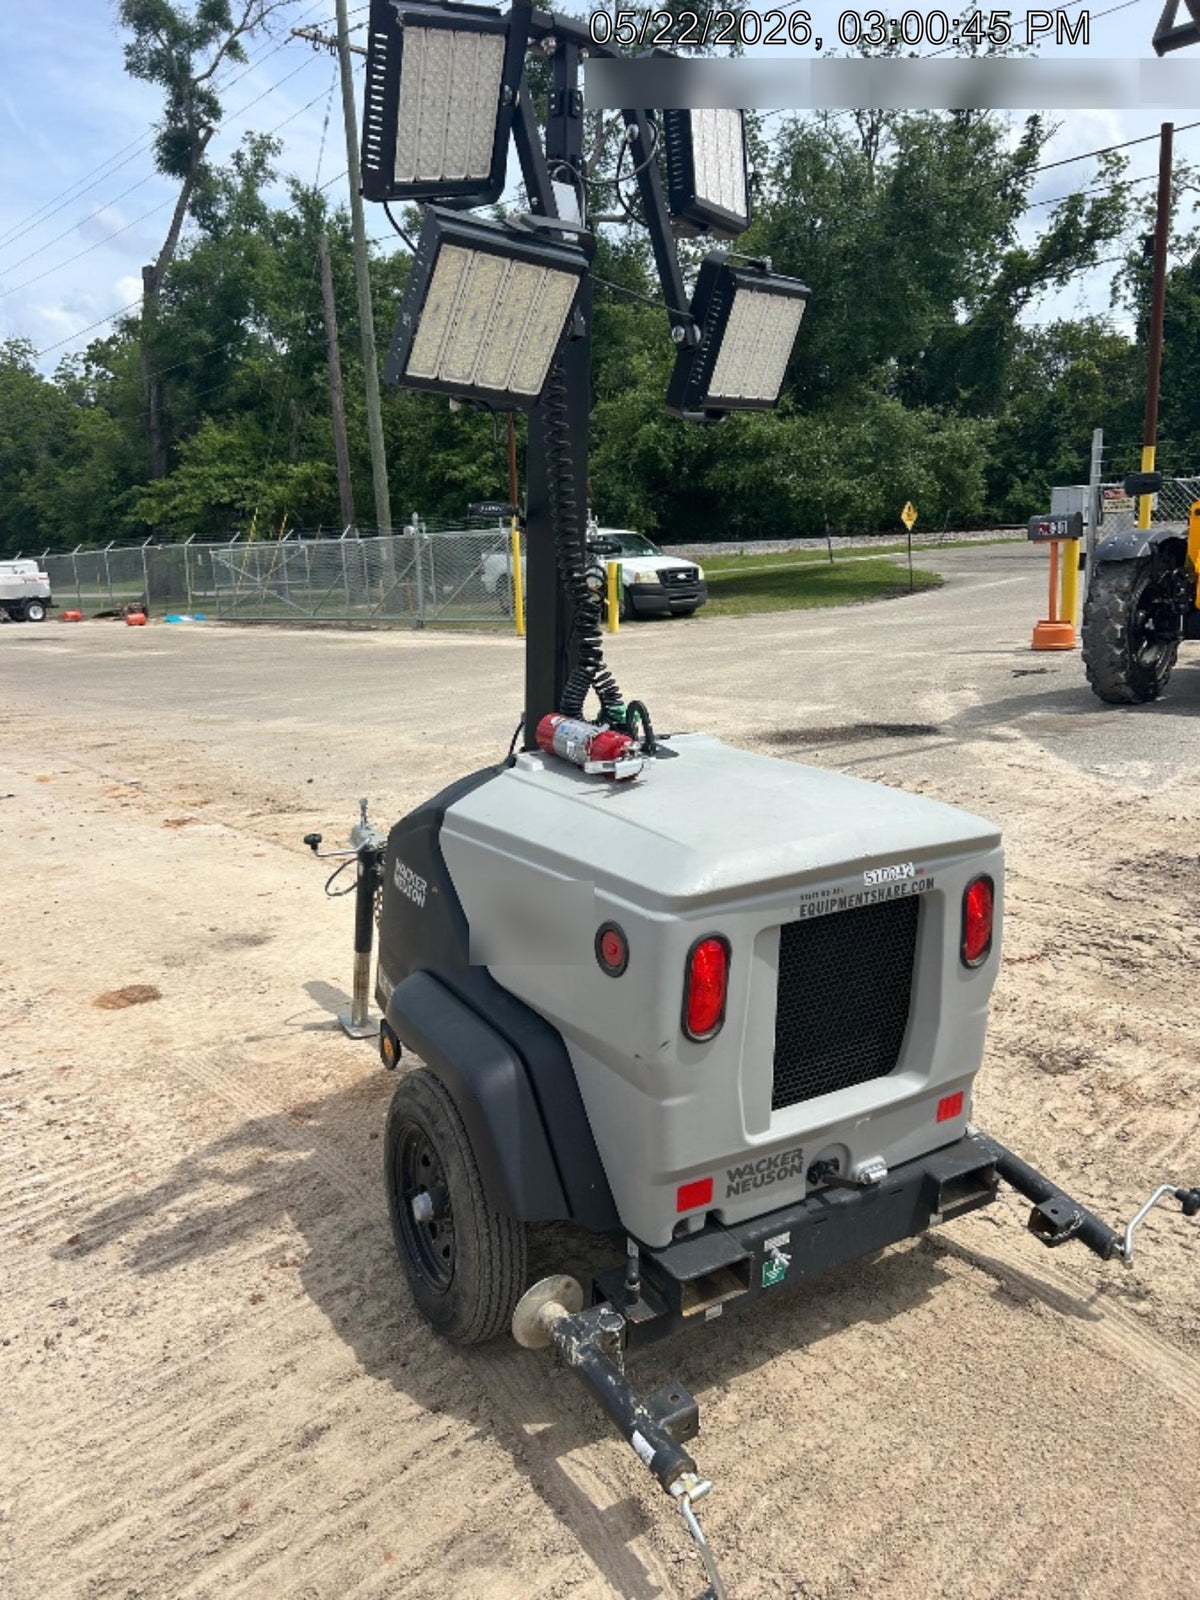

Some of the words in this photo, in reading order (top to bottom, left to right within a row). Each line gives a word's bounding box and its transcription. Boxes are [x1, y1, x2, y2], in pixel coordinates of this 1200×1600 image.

[800, 877, 935, 918] EQUIPMENTSHARE.COM
[725, 1161, 804, 1199] NEUSON
[726, 1148, 804, 1182] WACKER
